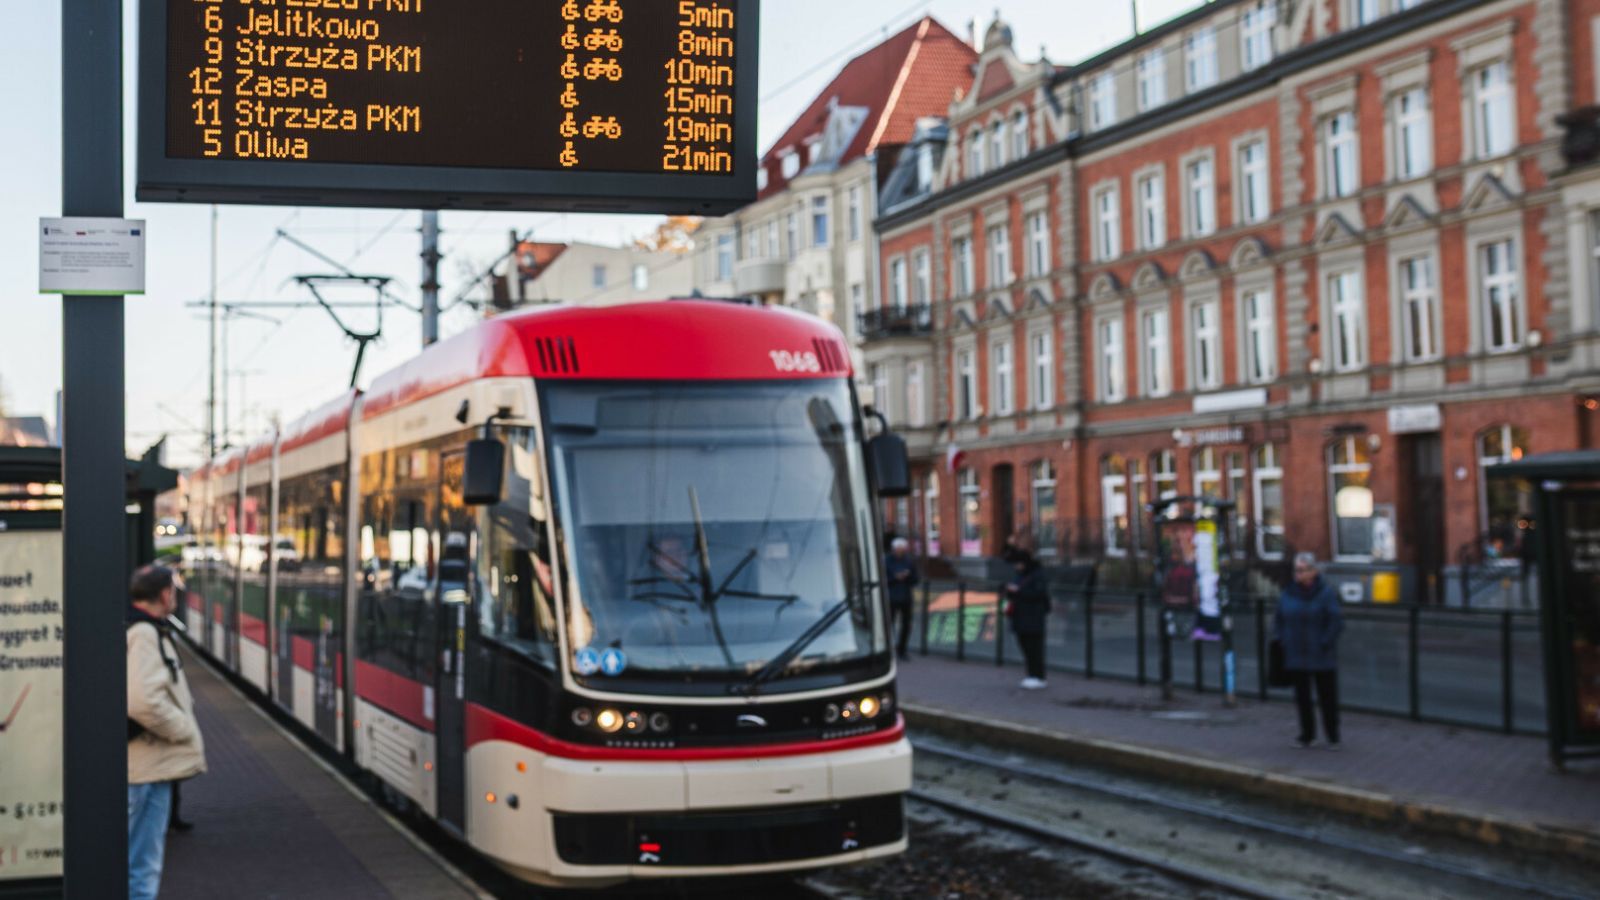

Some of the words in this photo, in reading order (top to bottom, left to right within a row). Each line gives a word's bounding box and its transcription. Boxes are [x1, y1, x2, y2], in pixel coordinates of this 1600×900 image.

[204, 6, 223, 33] 6
[236, 8, 380, 40] Jelitkowo
[678, 30, 734, 57] 8min
[678, 1, 734, 28] 5min
[204, 37, 223, 63] 9
[235, 39, 358, 70] Strzyża
[367, 44, 421, 72] PKM
[664, 58, 733, 86] 10min
[188, 67, 223, 95] 12
[235, 69, 328, 98] Zaspa
[664, 87, 733, 114] 15min
[191, 98, 222, 125] 11
[235, 100, 357, 130] Strzyża
[366, 105, 420, 132] PKM
[663, 115, 732, 142] 19min
[203, 129, 222, 156] 5
[234, 130, 309, 159] Oliwa
[663, 144, 732, 171] 21min
[768, 350, 820, 373] 1068
